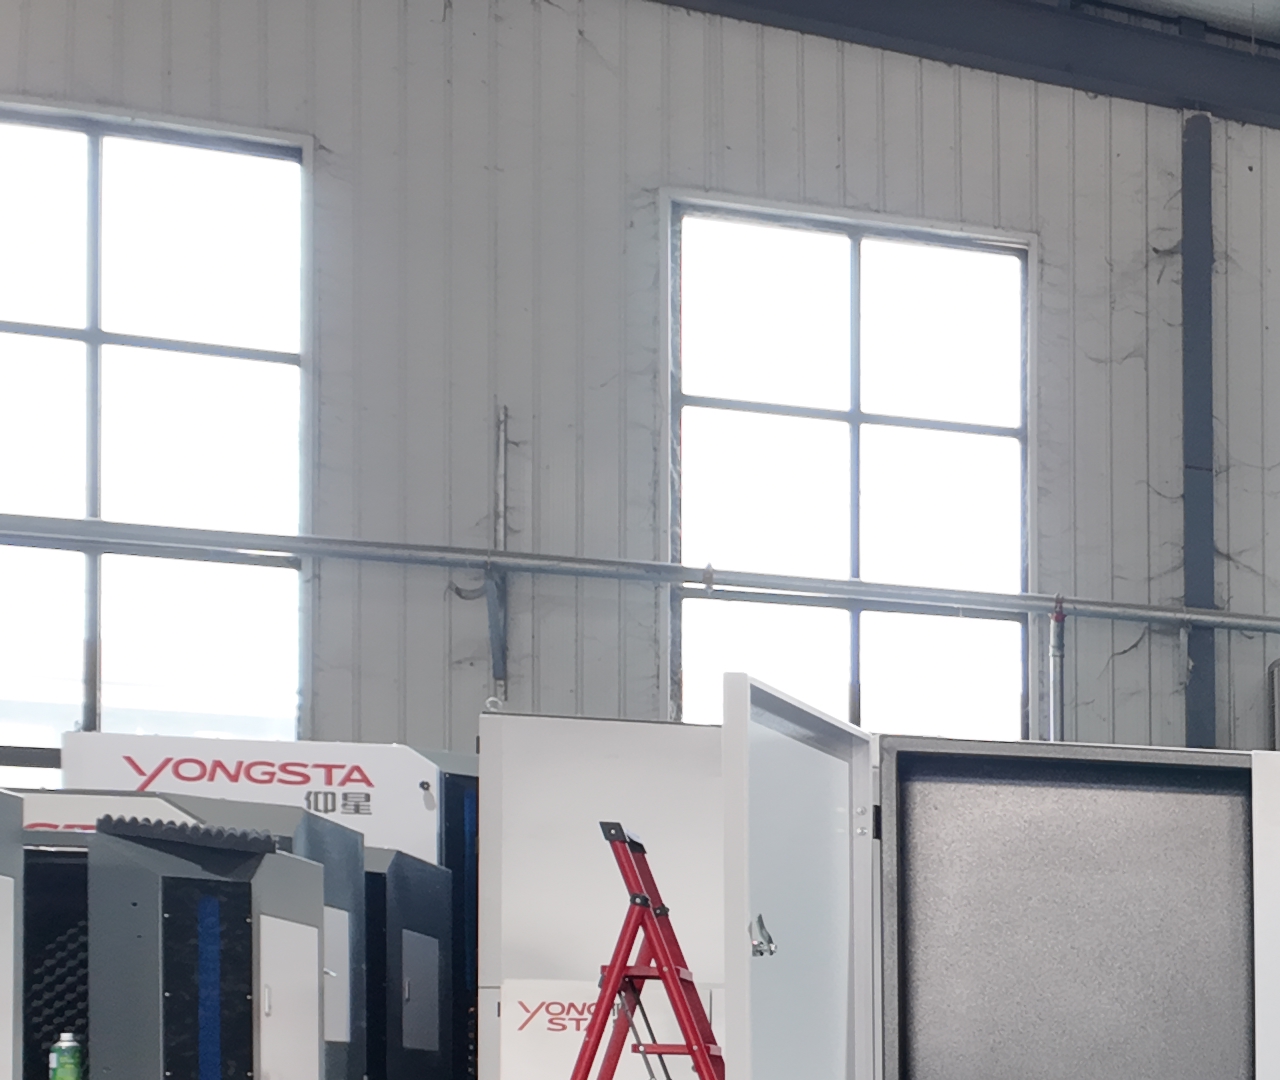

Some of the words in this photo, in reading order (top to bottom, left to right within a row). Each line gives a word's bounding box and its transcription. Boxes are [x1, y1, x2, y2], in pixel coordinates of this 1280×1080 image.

[122, 755, 375, 792] YONGSTA
[303, 790, 373, 816] 仰星
[546, 1017, 591, 1032] ST
